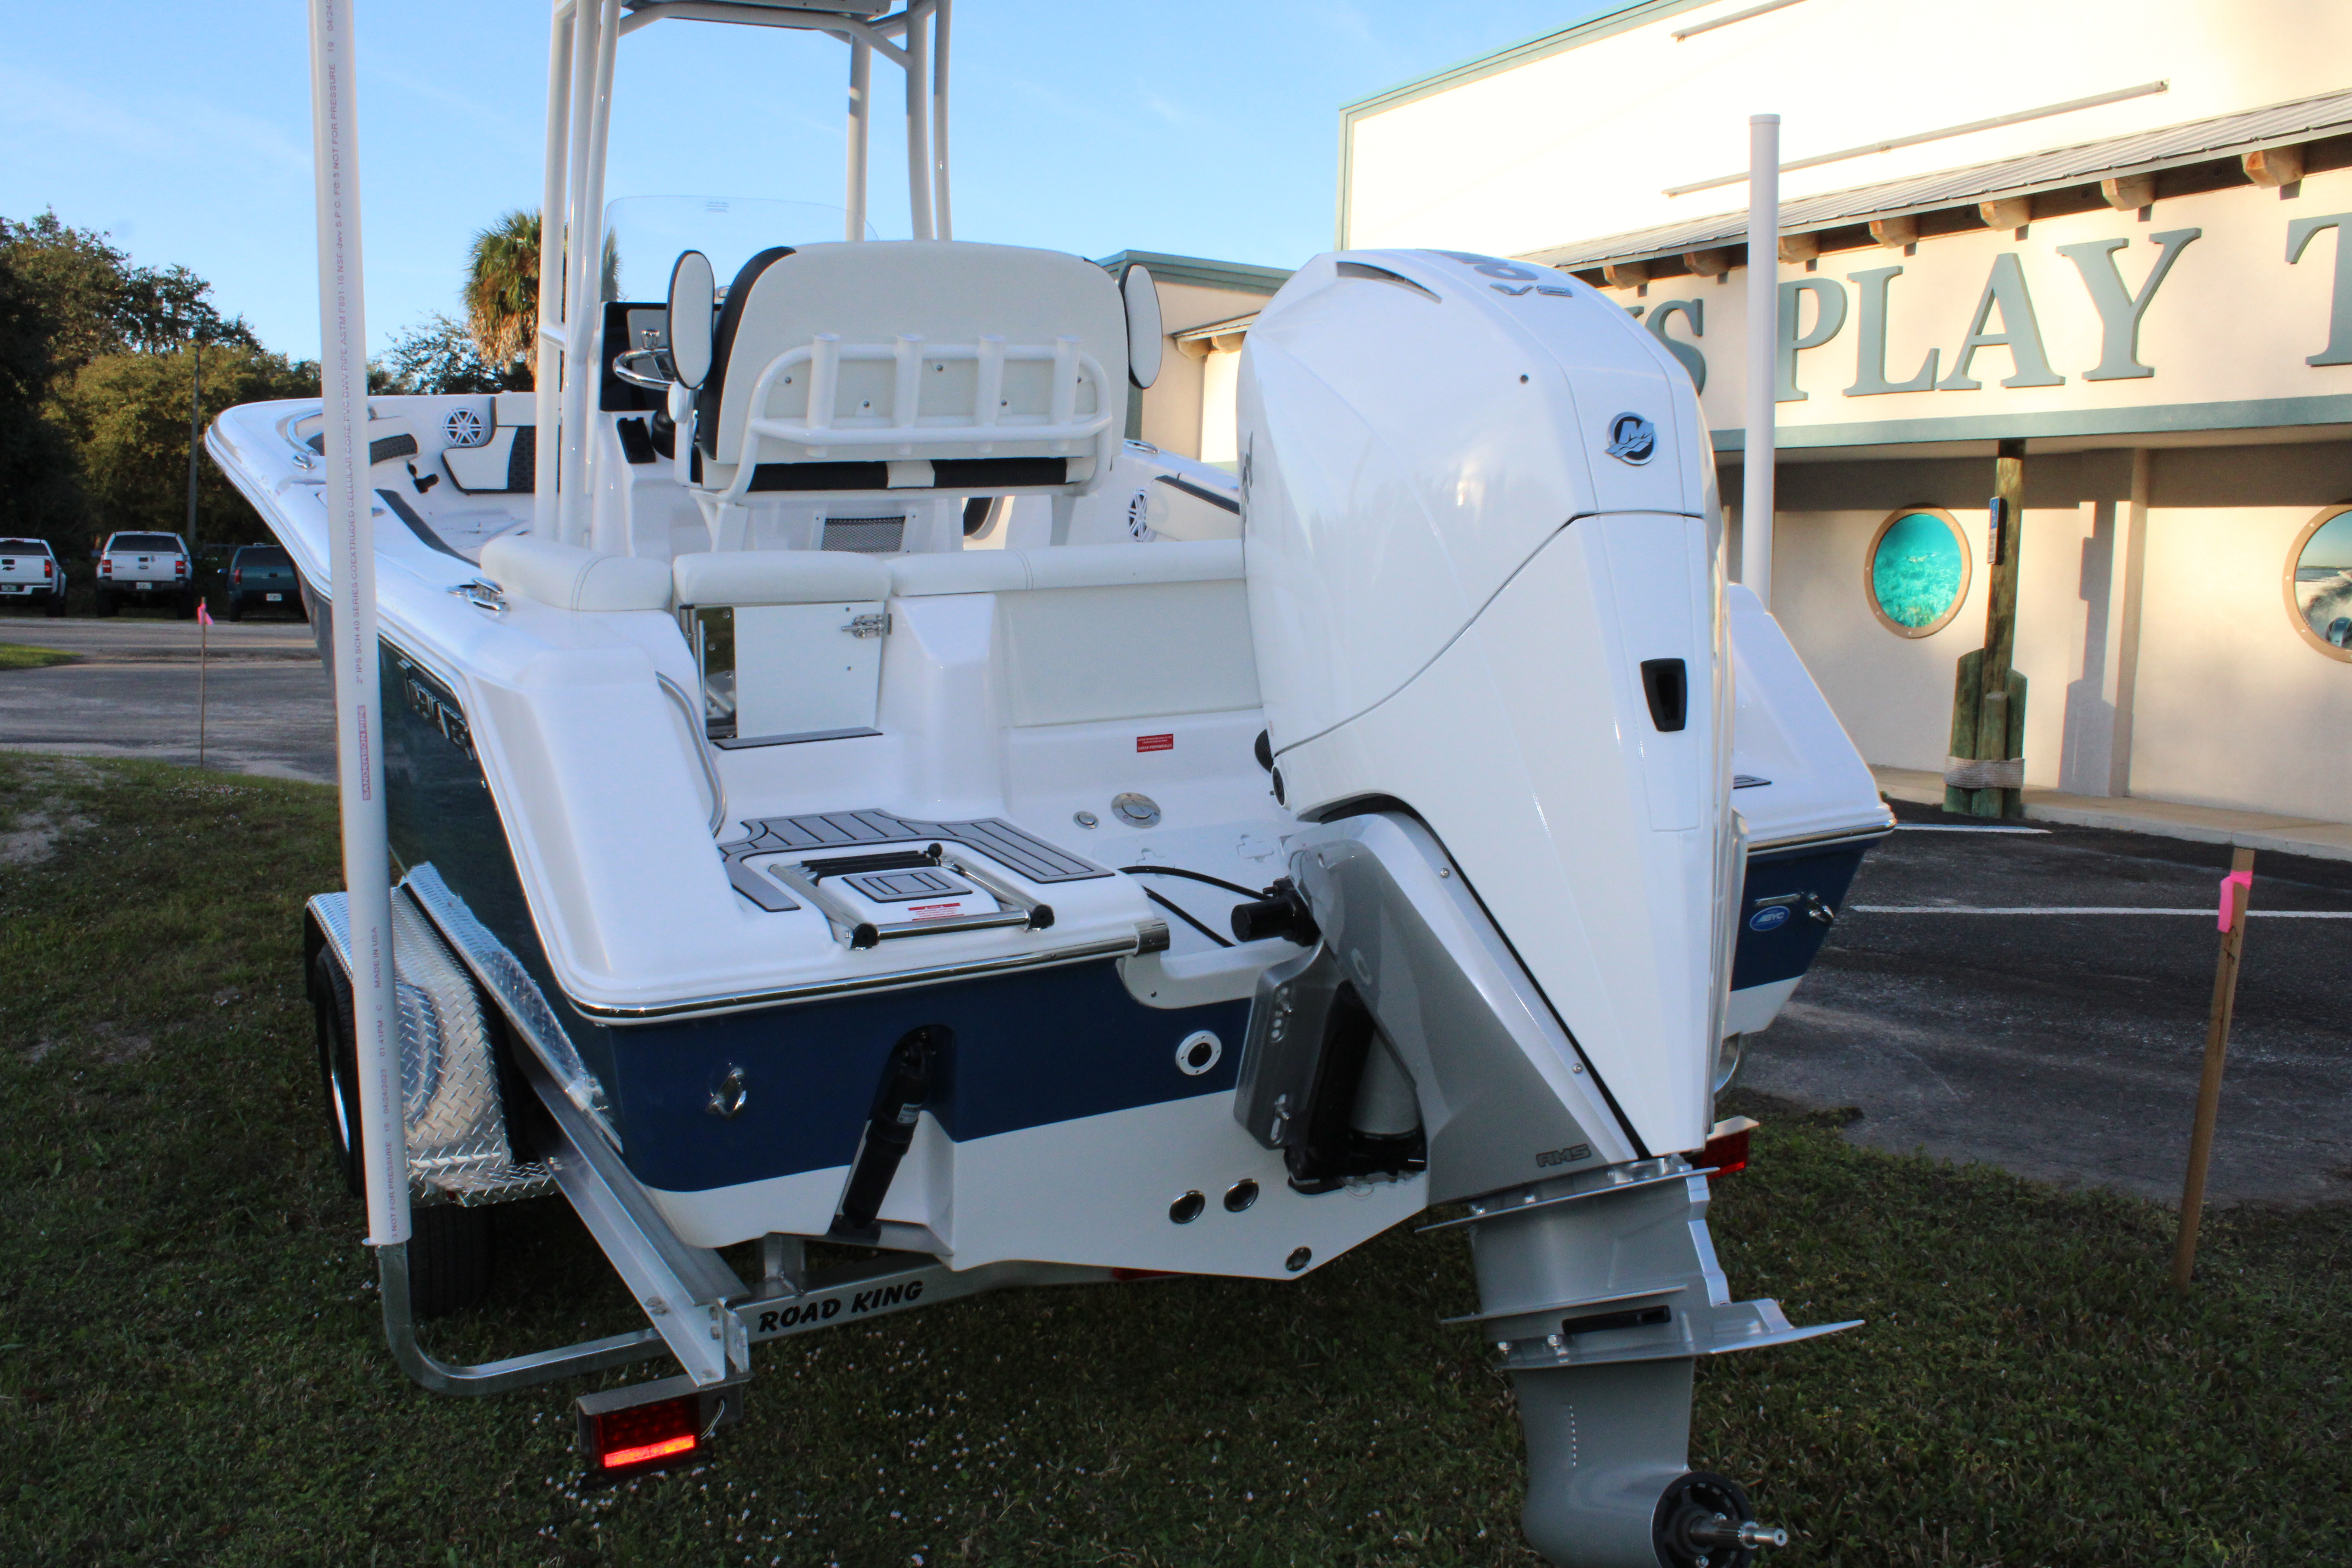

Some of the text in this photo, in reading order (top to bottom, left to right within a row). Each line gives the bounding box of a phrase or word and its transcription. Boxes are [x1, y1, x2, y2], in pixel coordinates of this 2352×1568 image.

[327, 42, 334, 52] 19
[328, 64, 337, 120] PRESSURE
[1775, 227, 2202, 403] PLAY
[341, 374, 350, 398] DWV
[342, 401, 350, 421] PVC
[343, 425, 352, 454] CORE
[345, 457, 354, 508] CELLULAR
[348, 510, 358, 579] COEXTRUDED
[351, 582, 360, 617] SERIES
[353, 621, 361, 632] 40
[359, 733, 370, 800] SANDERSON
[372, 949, 379, 958] IN
[377, 1020, 386, 1057] 0141PM
[380, 1068, 389, 1114] 04/24/2023
[384, 1123, 390, 1132] 19
[385, 1142, 395, 1189] PRESSURE
[758, 1280, 924, 1332] ROAD KING
